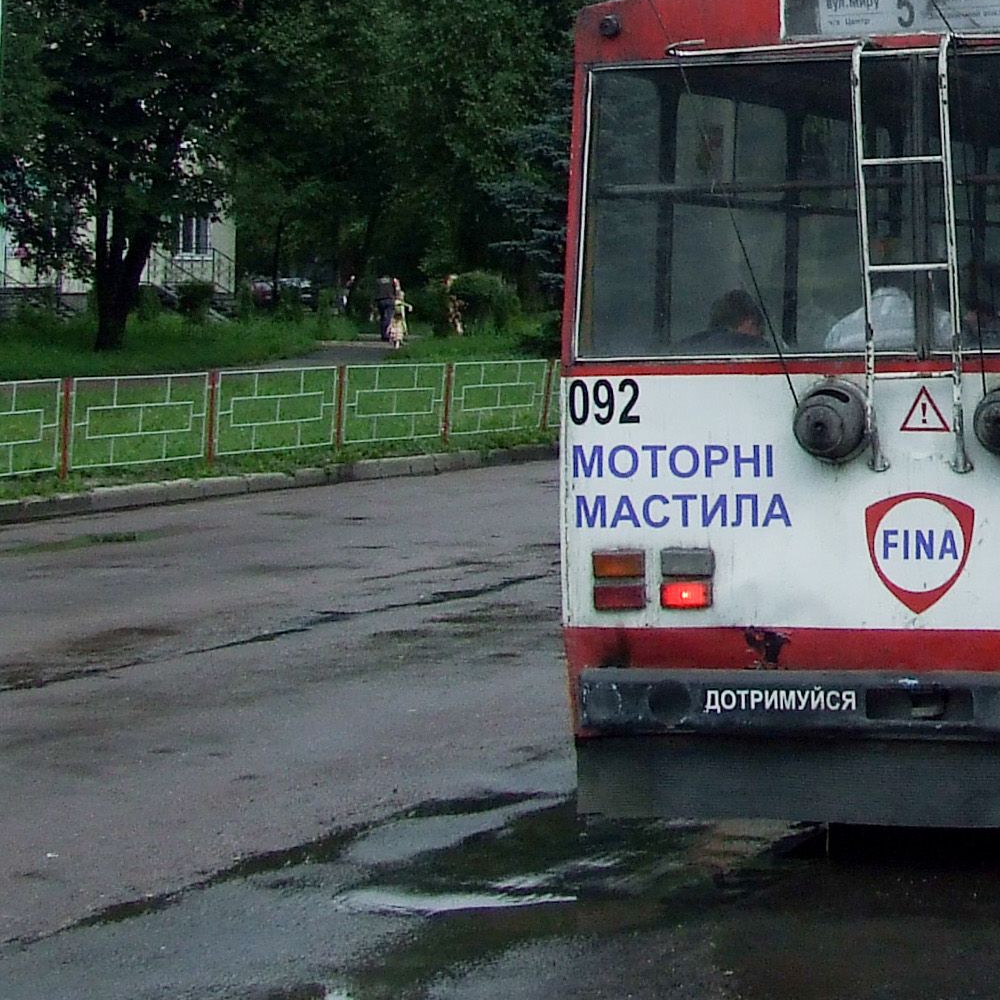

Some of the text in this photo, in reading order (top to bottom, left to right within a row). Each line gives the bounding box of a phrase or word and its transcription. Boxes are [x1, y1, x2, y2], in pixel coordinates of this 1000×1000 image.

[568, 378, 641, 426] 092
[572, 444, 775, 479] МОТОРНІ
[575, 493, 792, 529] МАСТИЛА
[882, 528, 960, 560] FINA
[705, 686, 857, 715] ДОТРИМУЙСЯ
